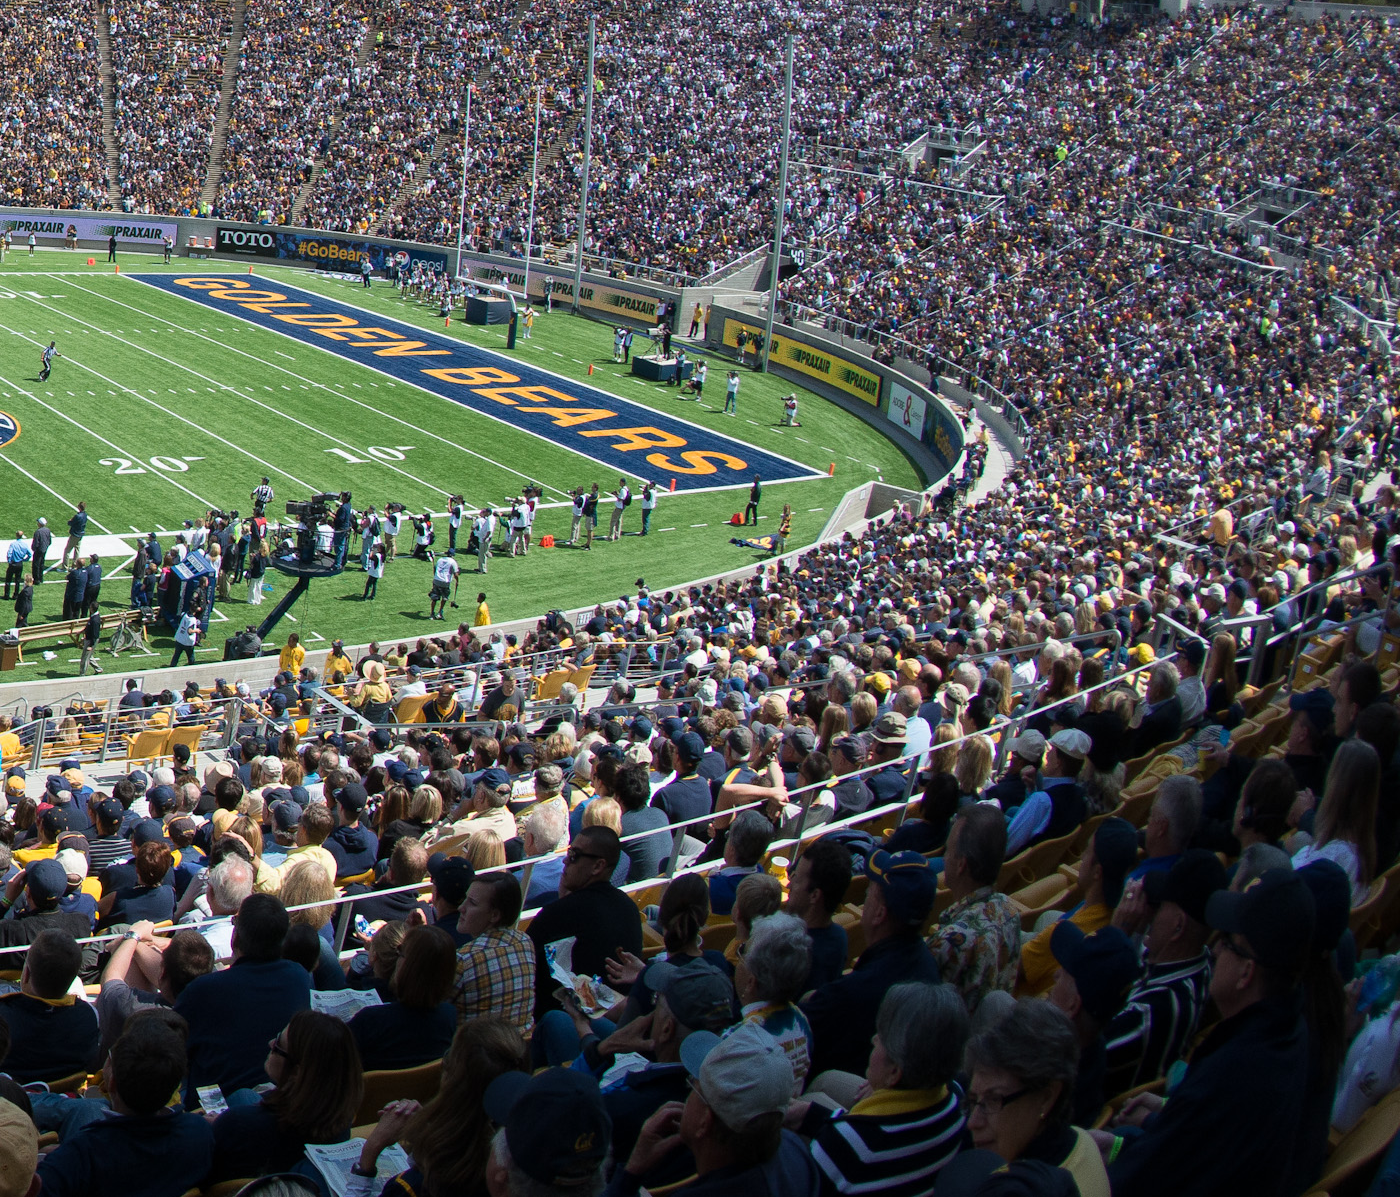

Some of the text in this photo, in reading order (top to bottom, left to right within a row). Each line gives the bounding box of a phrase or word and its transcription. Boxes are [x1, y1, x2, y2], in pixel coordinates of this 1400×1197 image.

[17, 220, 64, 233] PRAXAIR
[115, 226, 162, 239] PRAXAIR
[220, 230, 273, 248] TOTO
[298, 241, 370, 262] #GoBears
[790, 249, 805, 267] 40
[411, 258, 444, 272] pepsi
[555, 281, 594, 301] PRAAIR
[619, 297, 656, 316] PRAXAIR
[801, 349, 831, 374] PRAXAIR
[173, 277, 748, 475] GOLDEN BEARS
[850, 370, 877, 394] PRAXAIR
[323, 446, 406, 463] 10
[99, 456, 189, 474] 20
